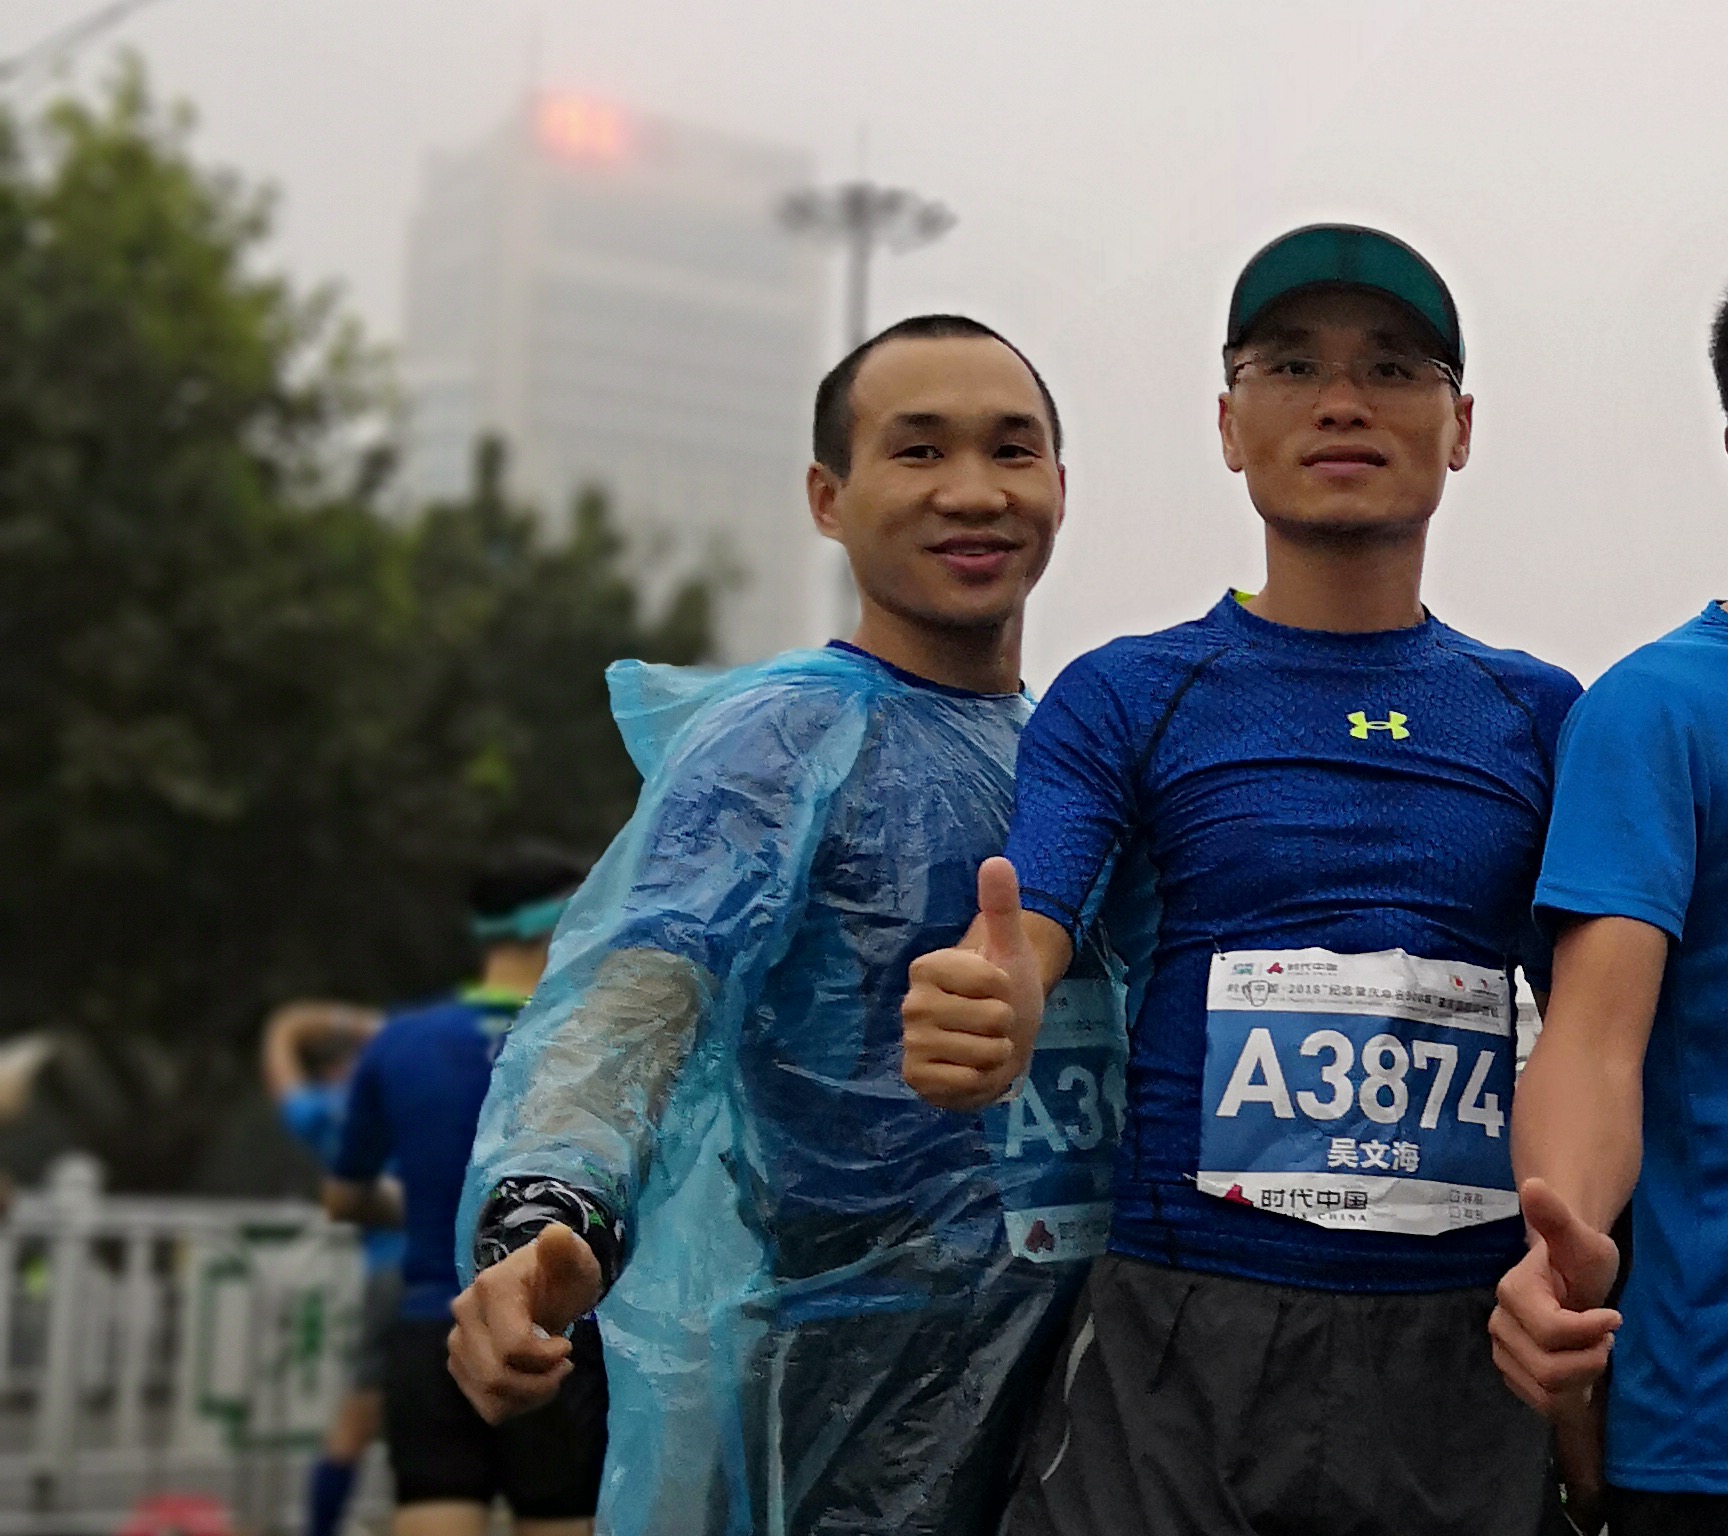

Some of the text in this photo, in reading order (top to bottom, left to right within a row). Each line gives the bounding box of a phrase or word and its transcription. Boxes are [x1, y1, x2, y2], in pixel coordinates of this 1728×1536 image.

[1005, 1065, 1127, 1158] A3
[1217, 1028, 1505, 1138] A3874
[1327, 1137, 1420, 1172] 吴文海
[1261, 1189, 1368, 1210] 时代中国
